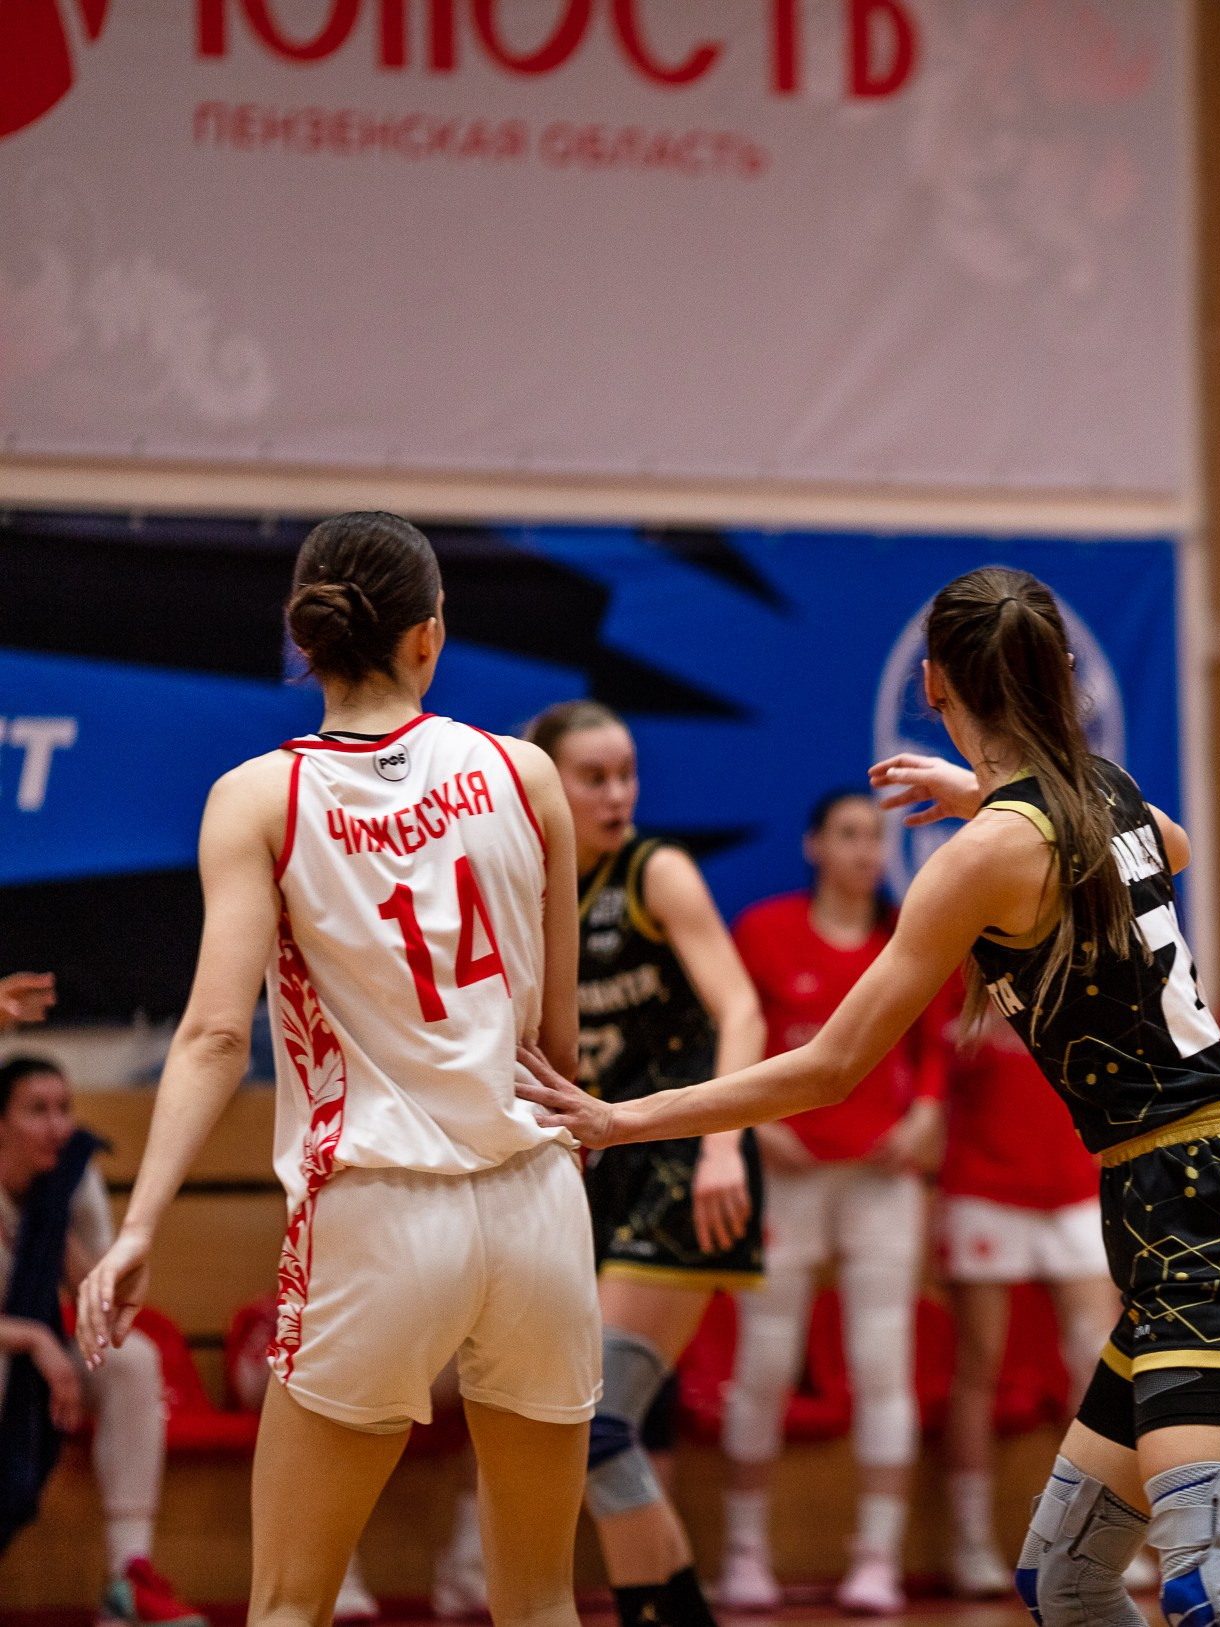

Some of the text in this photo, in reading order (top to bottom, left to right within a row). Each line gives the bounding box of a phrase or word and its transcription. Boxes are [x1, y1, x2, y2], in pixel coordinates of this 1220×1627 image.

[193, 102, 771, 179] ПЕНЗЕНСКАЯ ОБЛАСТЬ
[377, 855, 512, 1023] 14
